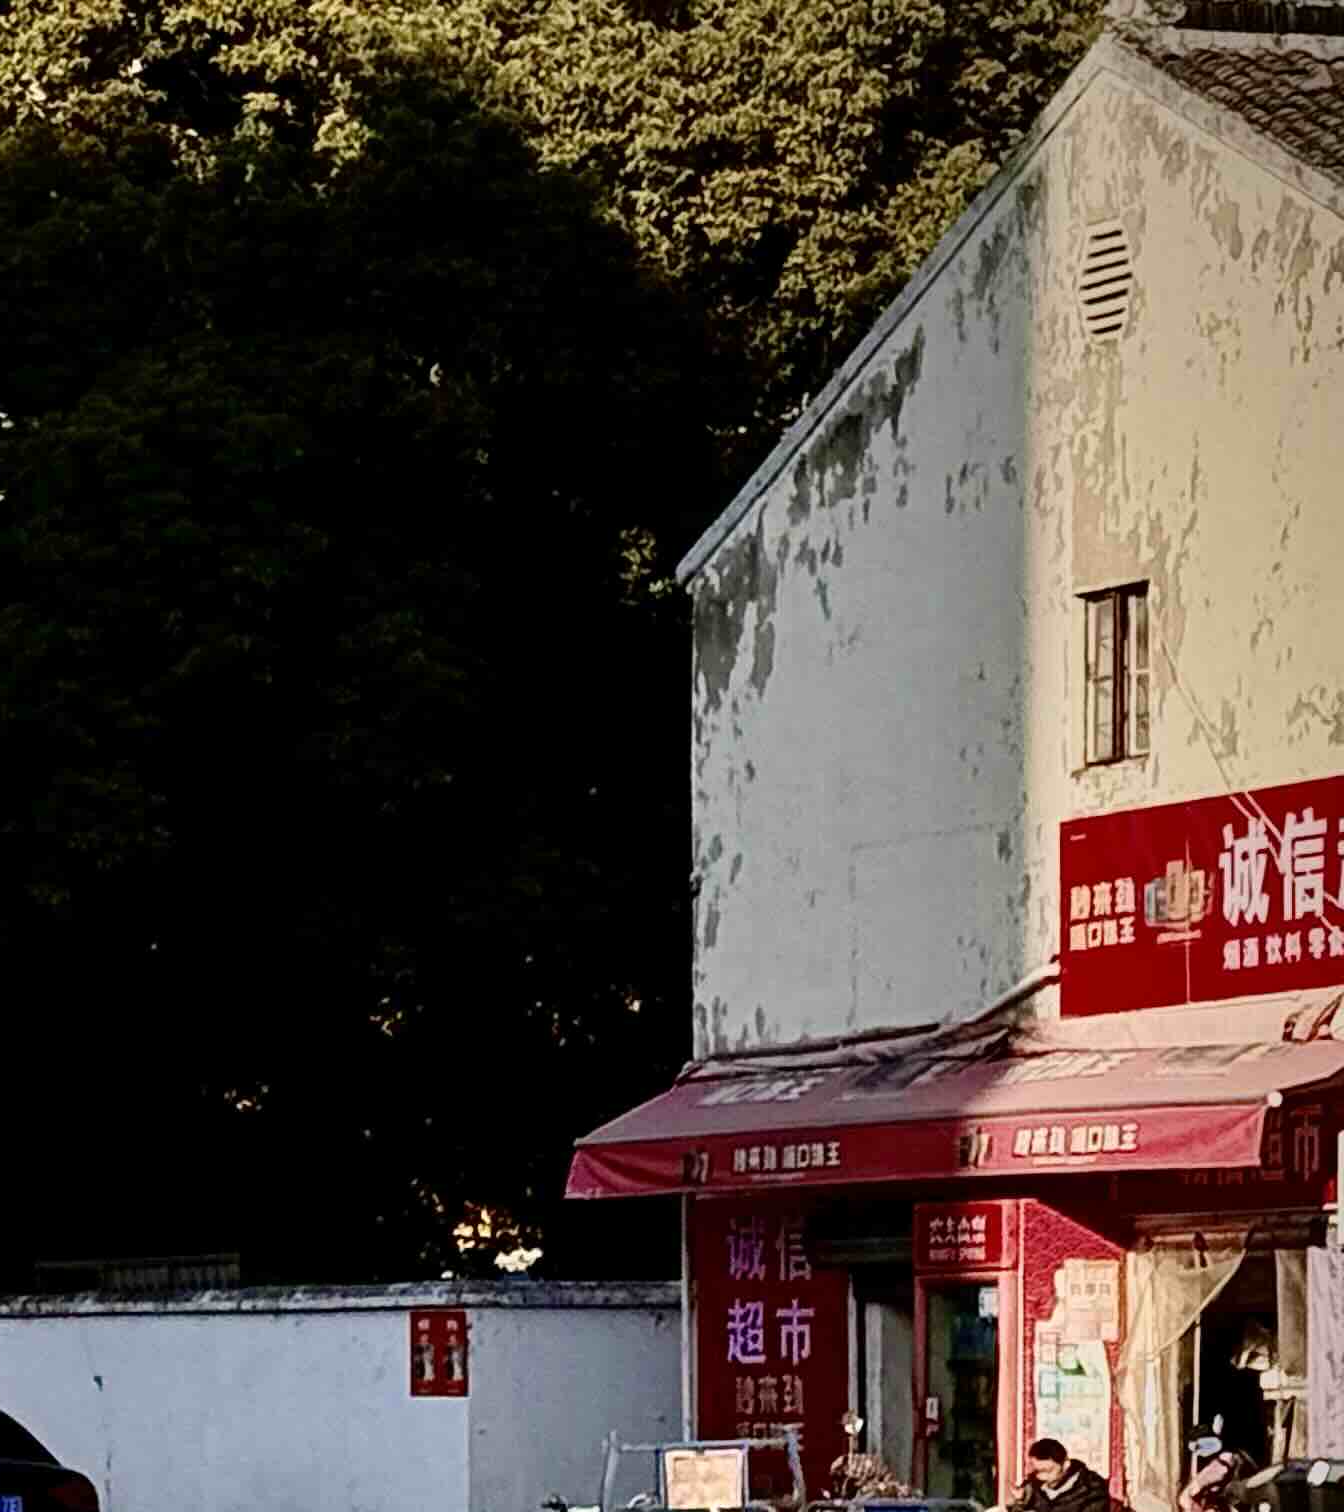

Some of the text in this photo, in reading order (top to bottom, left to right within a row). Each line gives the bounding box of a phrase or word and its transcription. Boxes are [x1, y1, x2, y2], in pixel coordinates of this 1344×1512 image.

[1219, 806, 1344, 927] 诚信
[723, 1216, 812, 1281] 诚信
[726, 1297, 816, 1367] 超市
